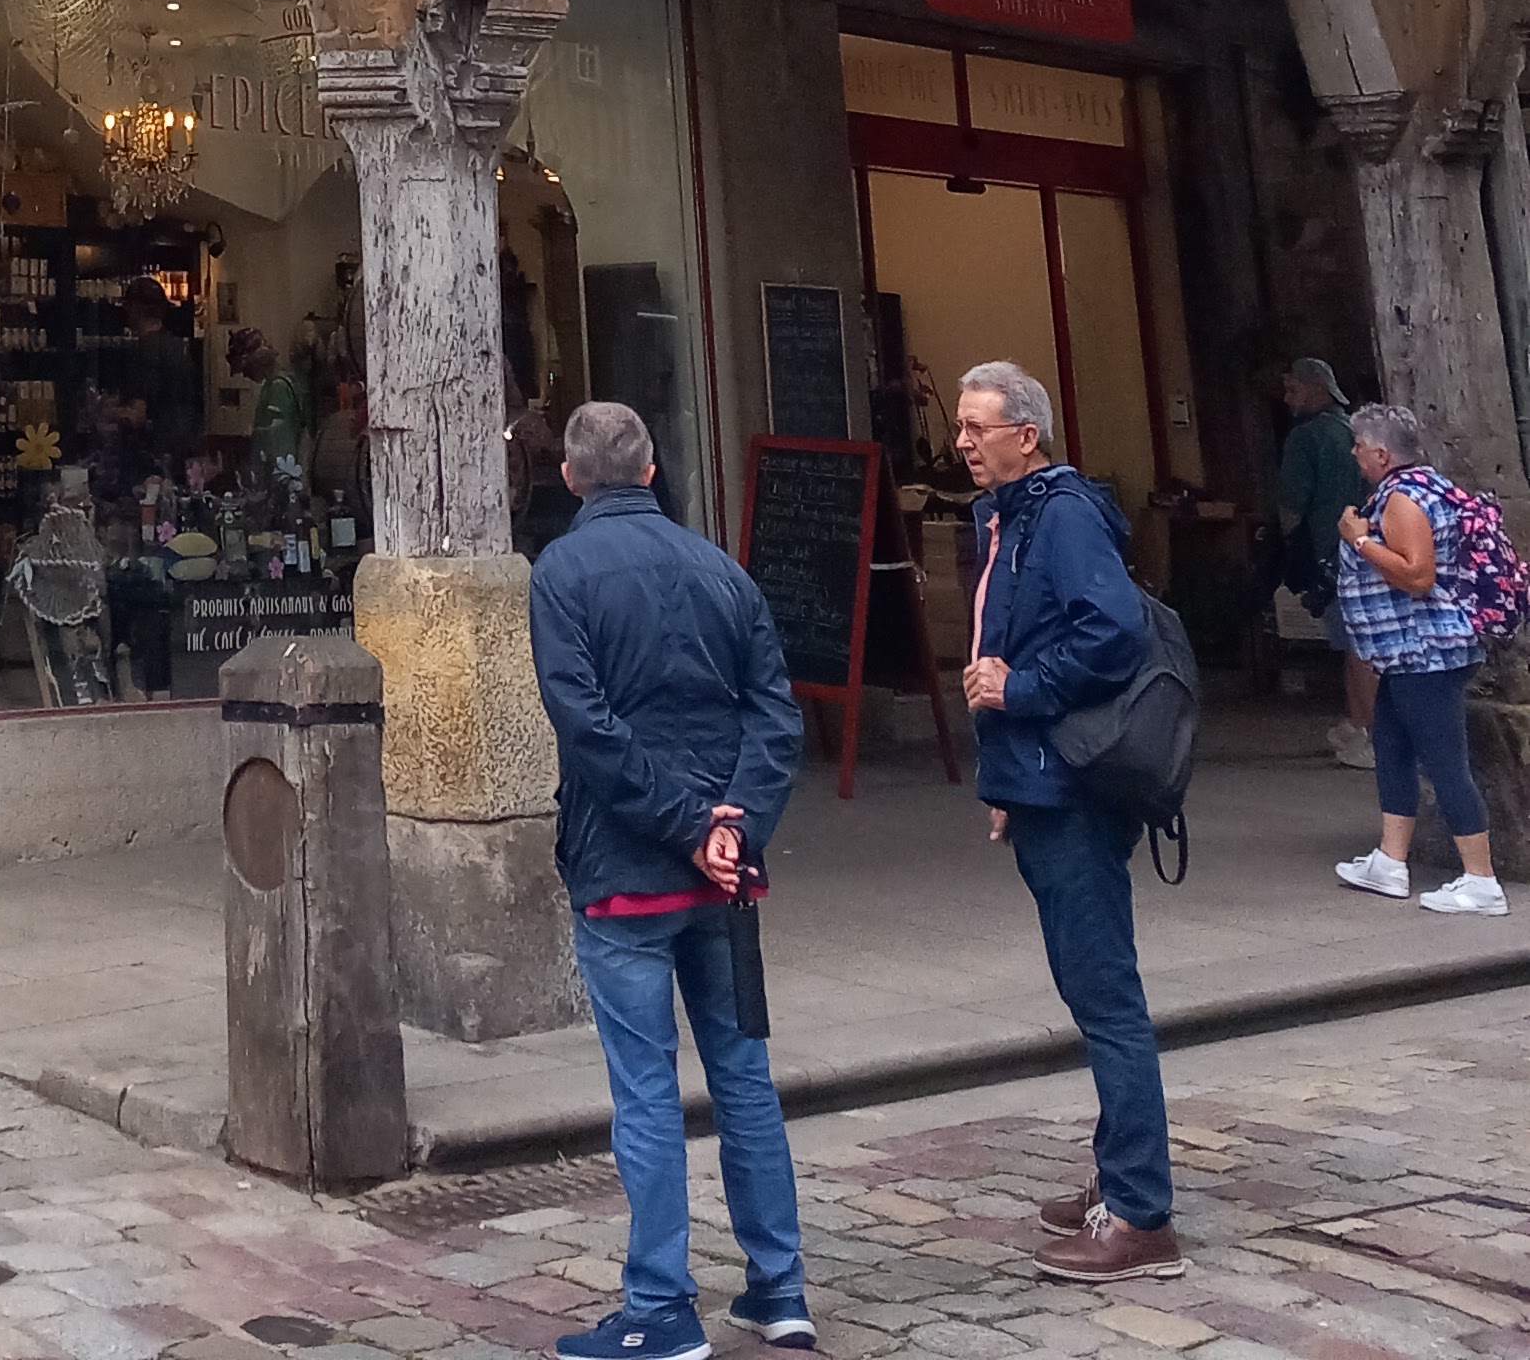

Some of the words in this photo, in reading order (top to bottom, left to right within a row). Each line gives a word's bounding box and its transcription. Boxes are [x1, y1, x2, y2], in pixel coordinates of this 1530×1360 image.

[193, 597, 245, 618] PRODUITS
[250, 595, 314, 616] ARTISANAUX
[214, 625, 242, 650] CAFÉ
